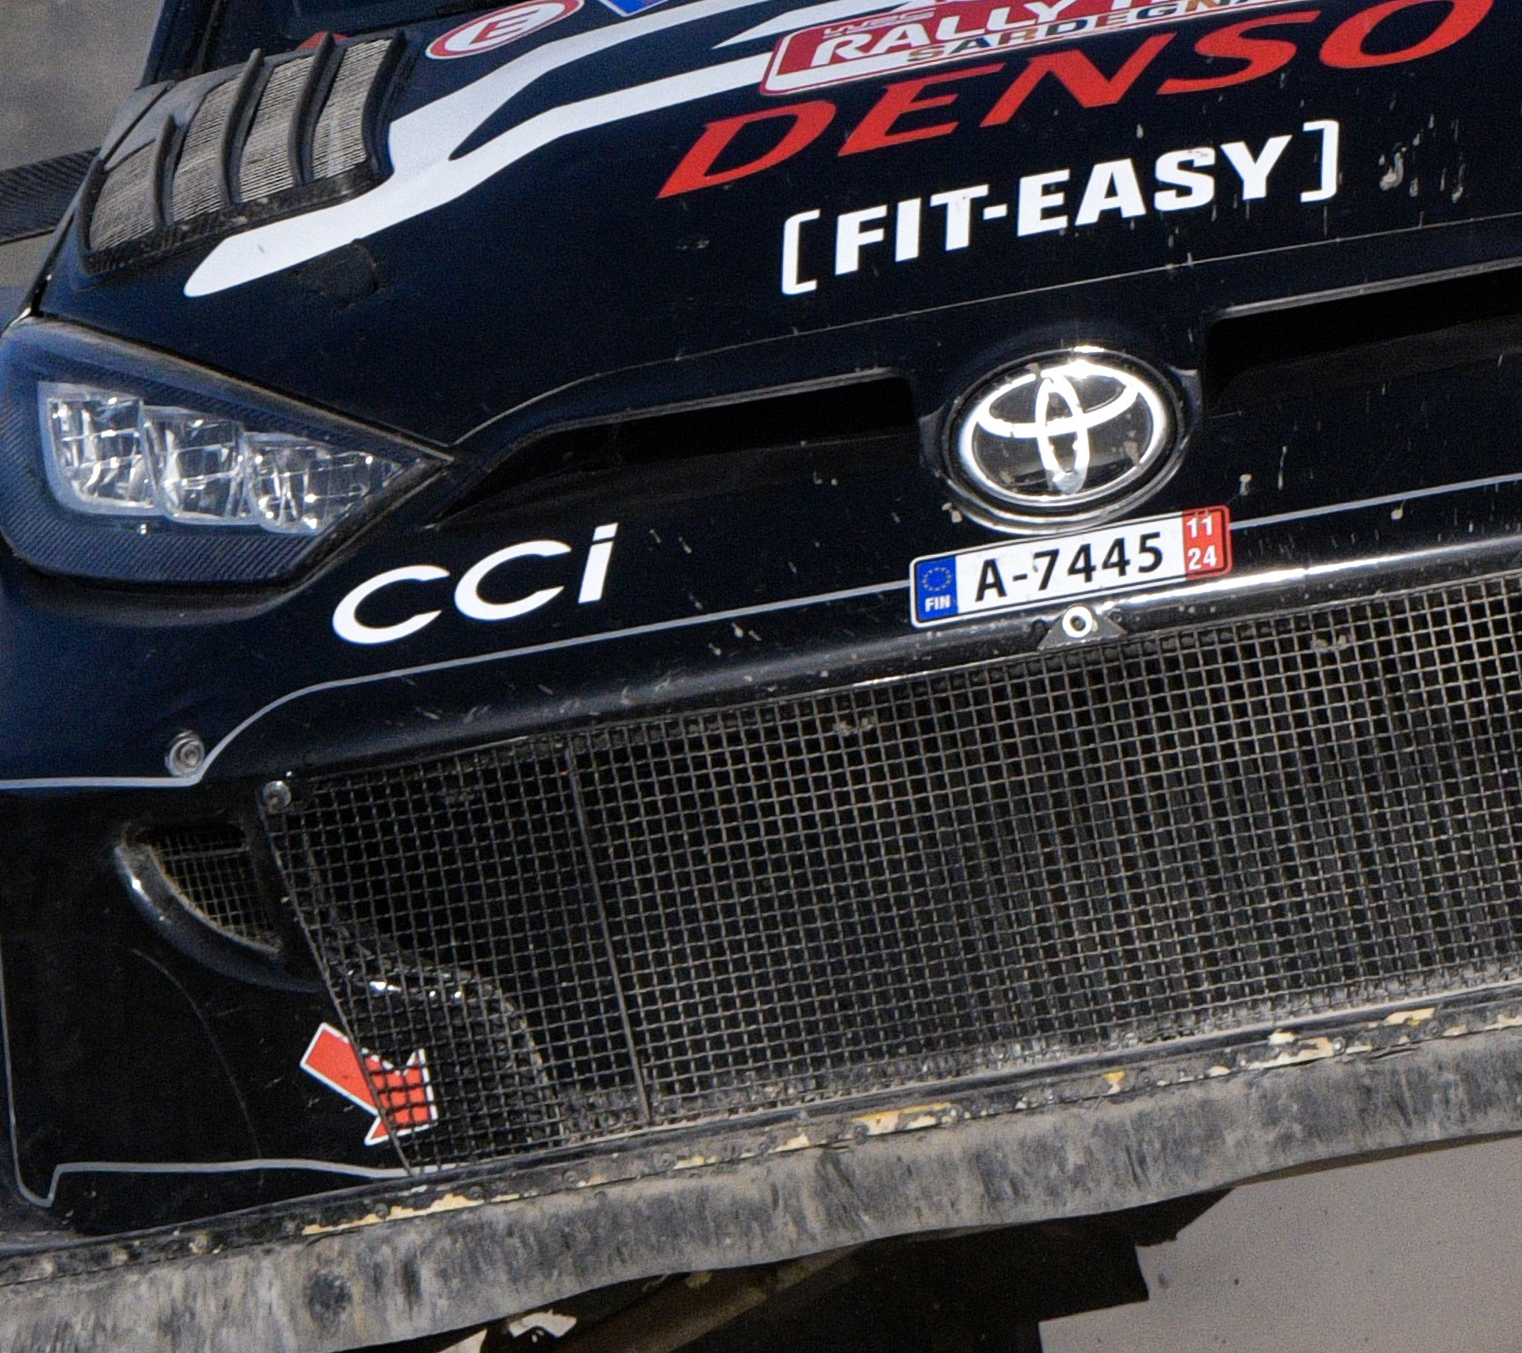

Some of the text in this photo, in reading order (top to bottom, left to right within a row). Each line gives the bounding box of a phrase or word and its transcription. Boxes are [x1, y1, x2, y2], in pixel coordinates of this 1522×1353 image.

[1186, 511, 1214, 540] 11
[924, 531, 1164, 613] FIN A-7445
[1186, 544, 1218, 572] 24
